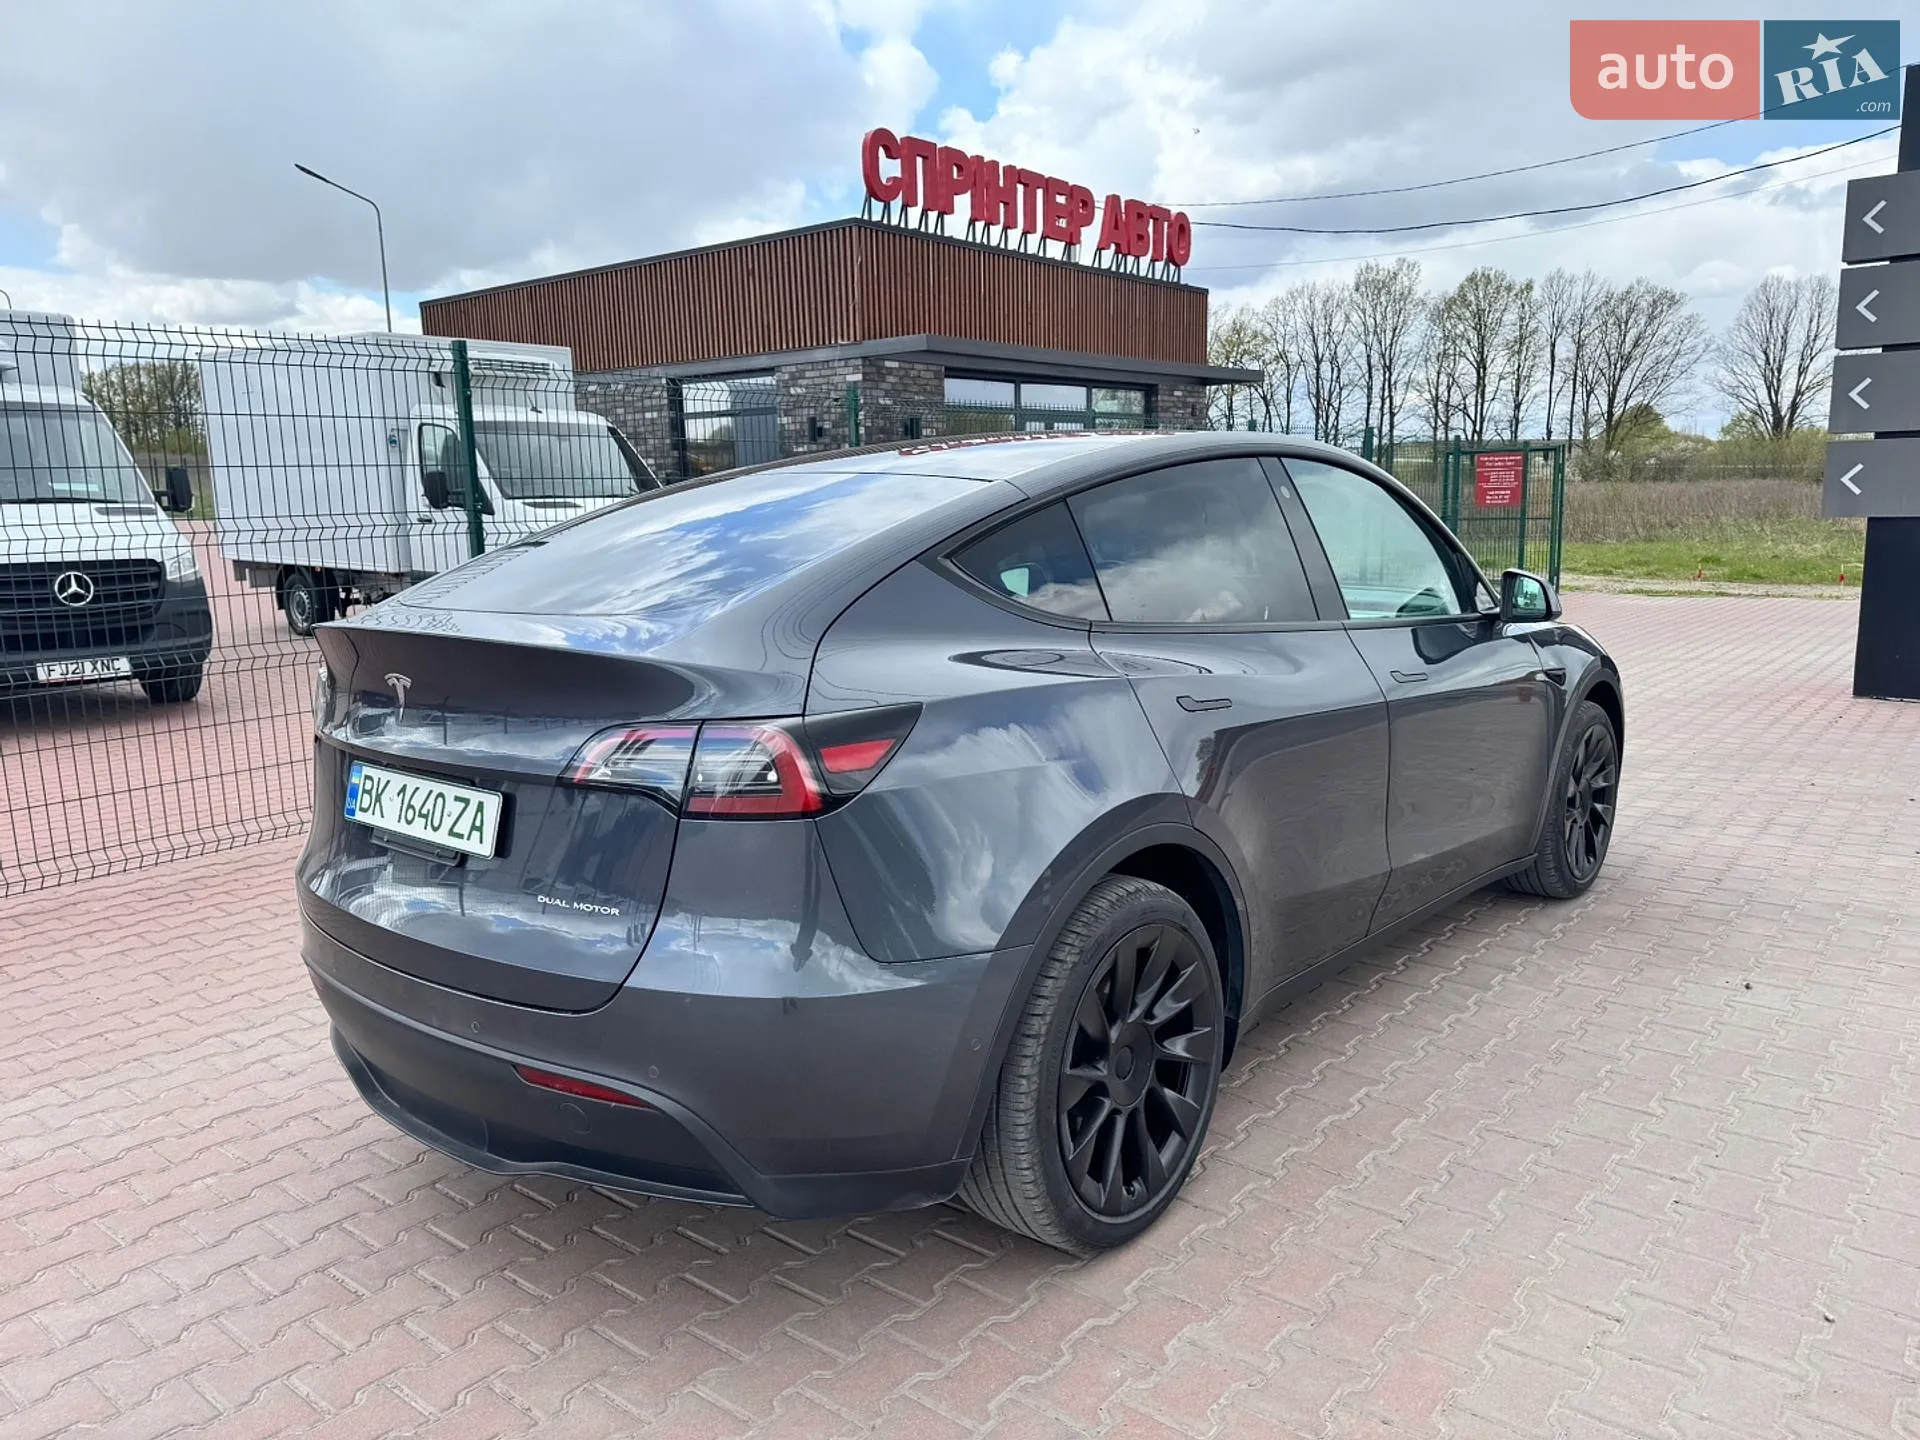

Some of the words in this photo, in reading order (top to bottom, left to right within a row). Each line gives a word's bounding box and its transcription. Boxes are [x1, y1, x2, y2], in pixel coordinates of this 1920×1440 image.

[862, 128, 1095, 245] СПРІНТЕР
[1100, 194, 1191, 267] АВТО
[359, 774, 391, 818] BK
[397, 783, 446, 832] 1640
[448, 796, 484, 845] ZA
[537, 895, 570, 908] DUAL
[573, 902, 620, 916] MOTOR
